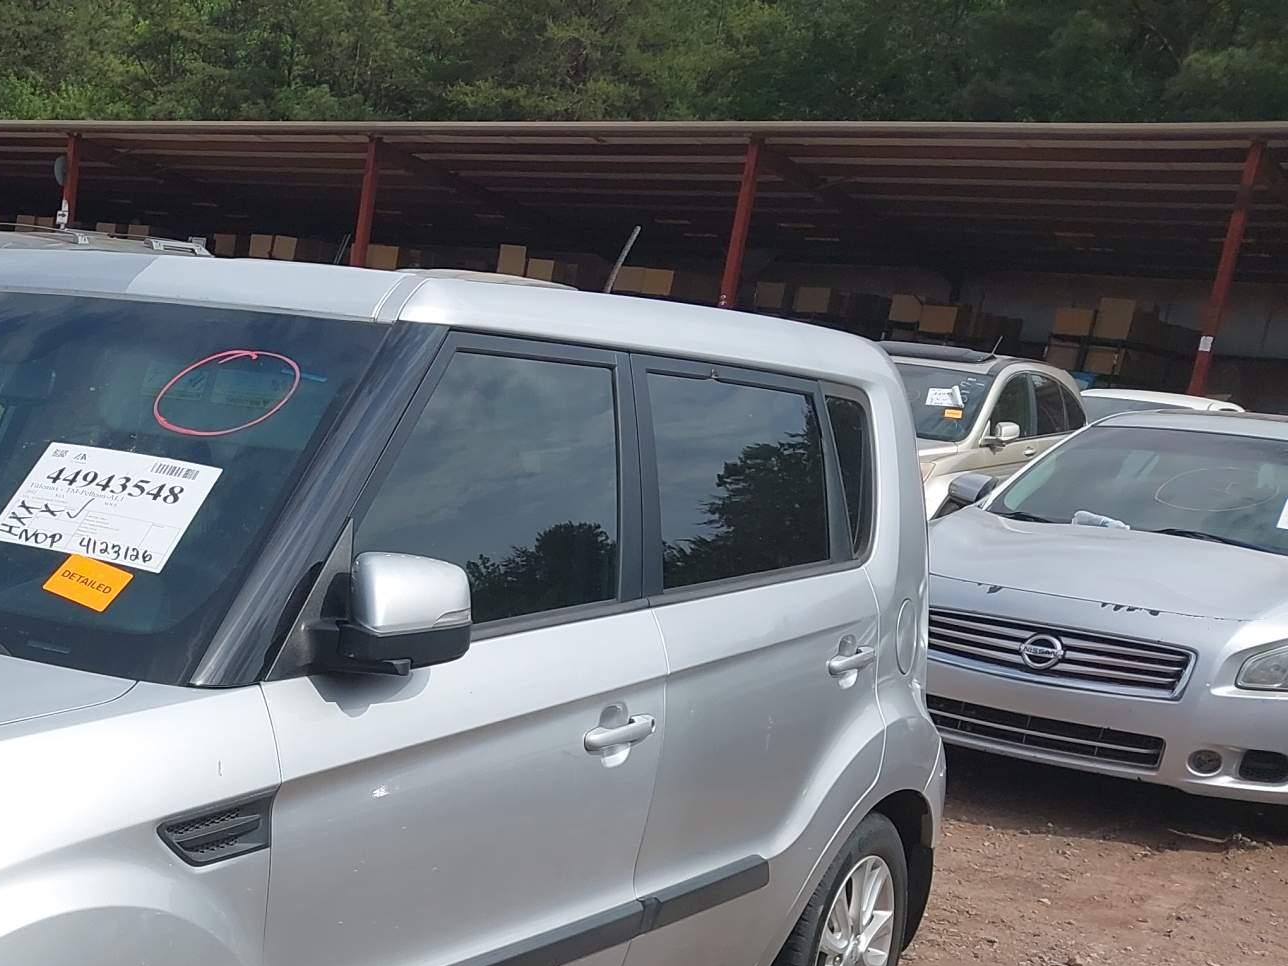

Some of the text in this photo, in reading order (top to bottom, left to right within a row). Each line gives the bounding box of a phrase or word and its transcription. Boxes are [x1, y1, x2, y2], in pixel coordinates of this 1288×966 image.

[46, 466, 185, 505] 44943548
[0, 522, 63, 548] INOP
[60, 568, 113, 595] DETAILED
